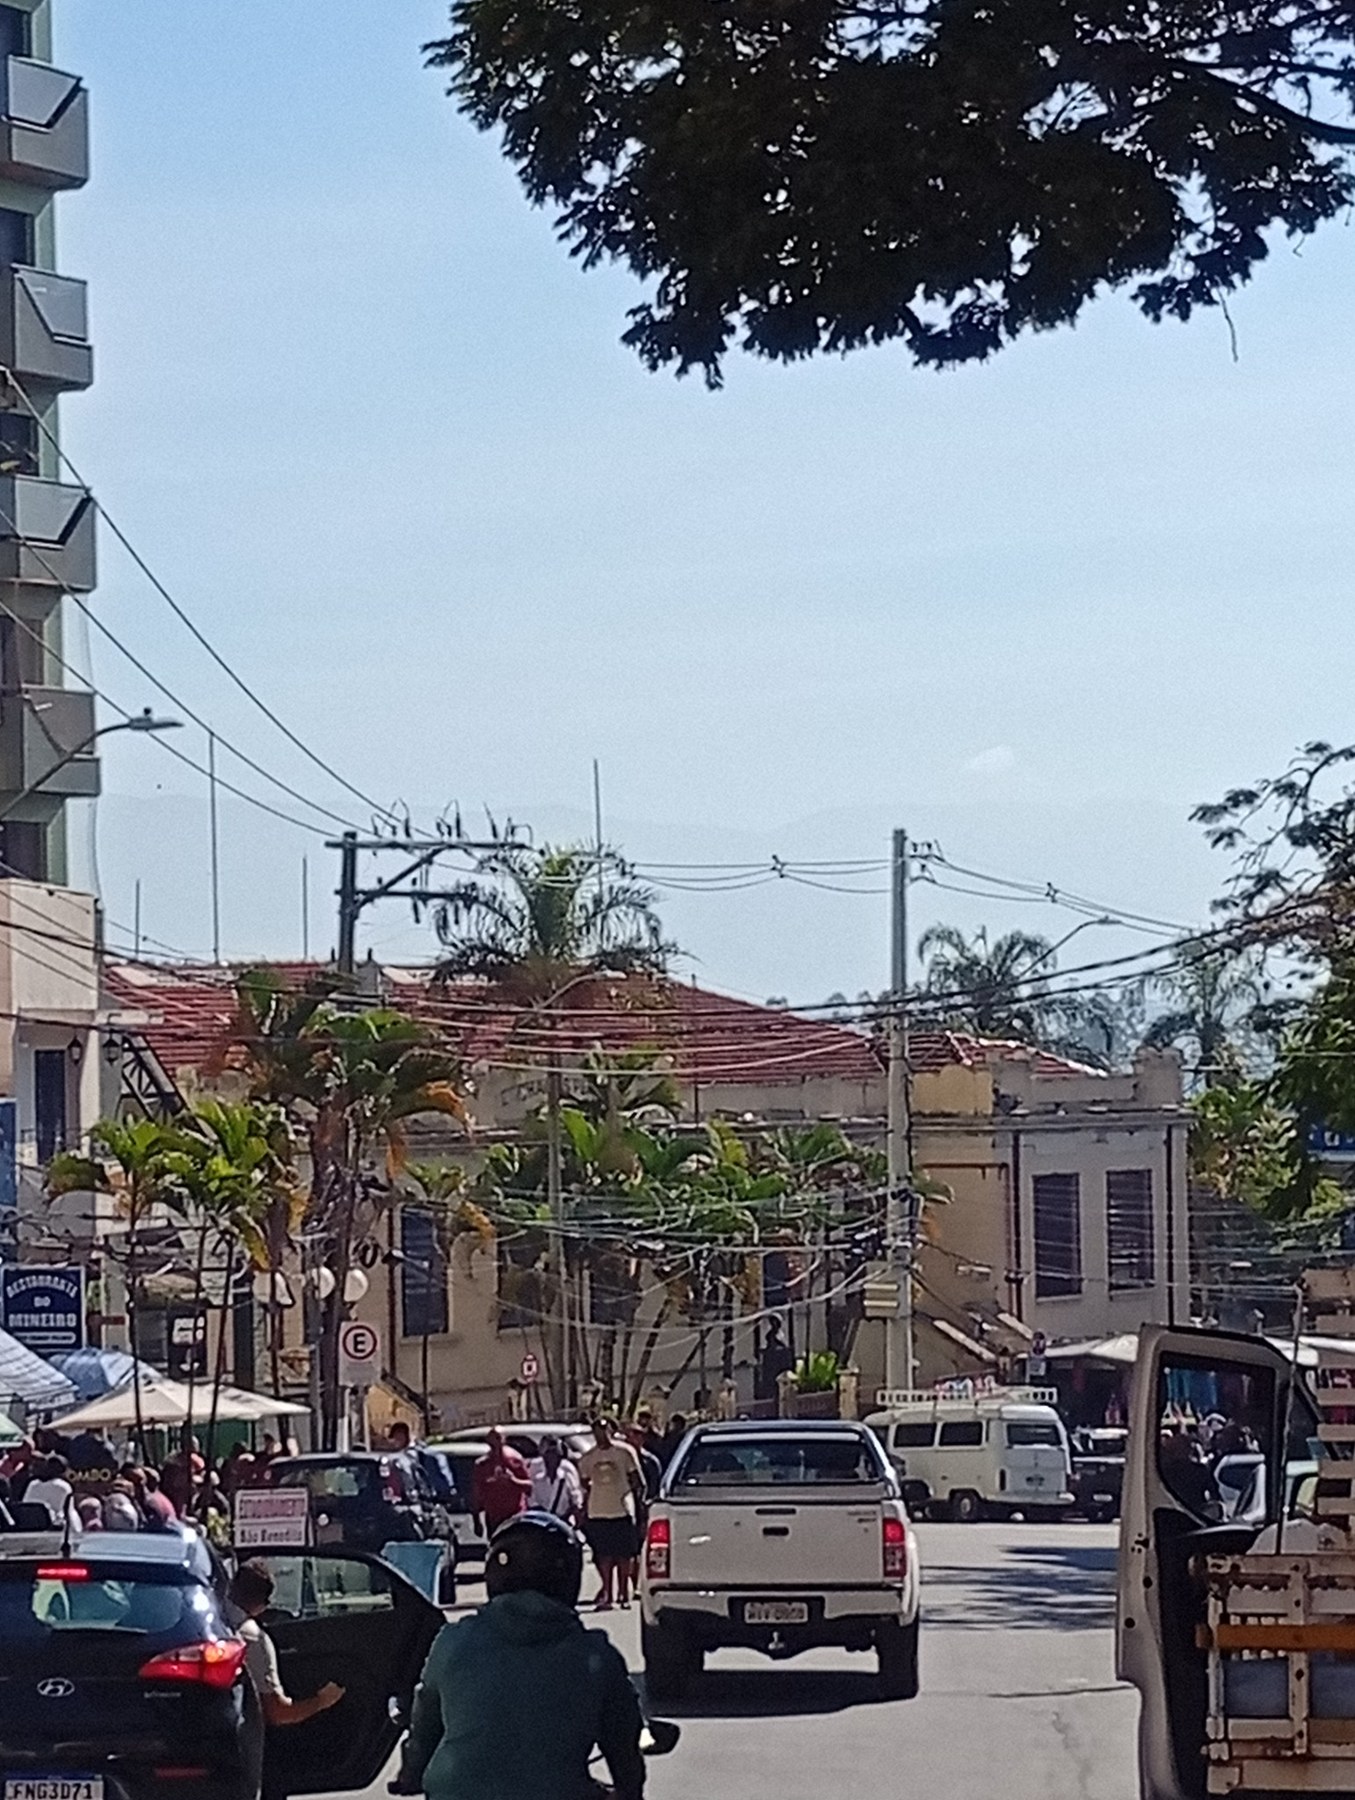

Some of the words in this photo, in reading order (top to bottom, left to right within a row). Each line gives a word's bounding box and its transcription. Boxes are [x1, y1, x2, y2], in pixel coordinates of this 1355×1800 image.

[6, 1275, 79, 1298] RESTAURANTE
[33, 1296, 51, 1307] DO
[8, 1313, 77, 1328] MINEIRO
[353, 1333, 366, 1353] E
[13, 1783, 92, 1800] FNG3D71
